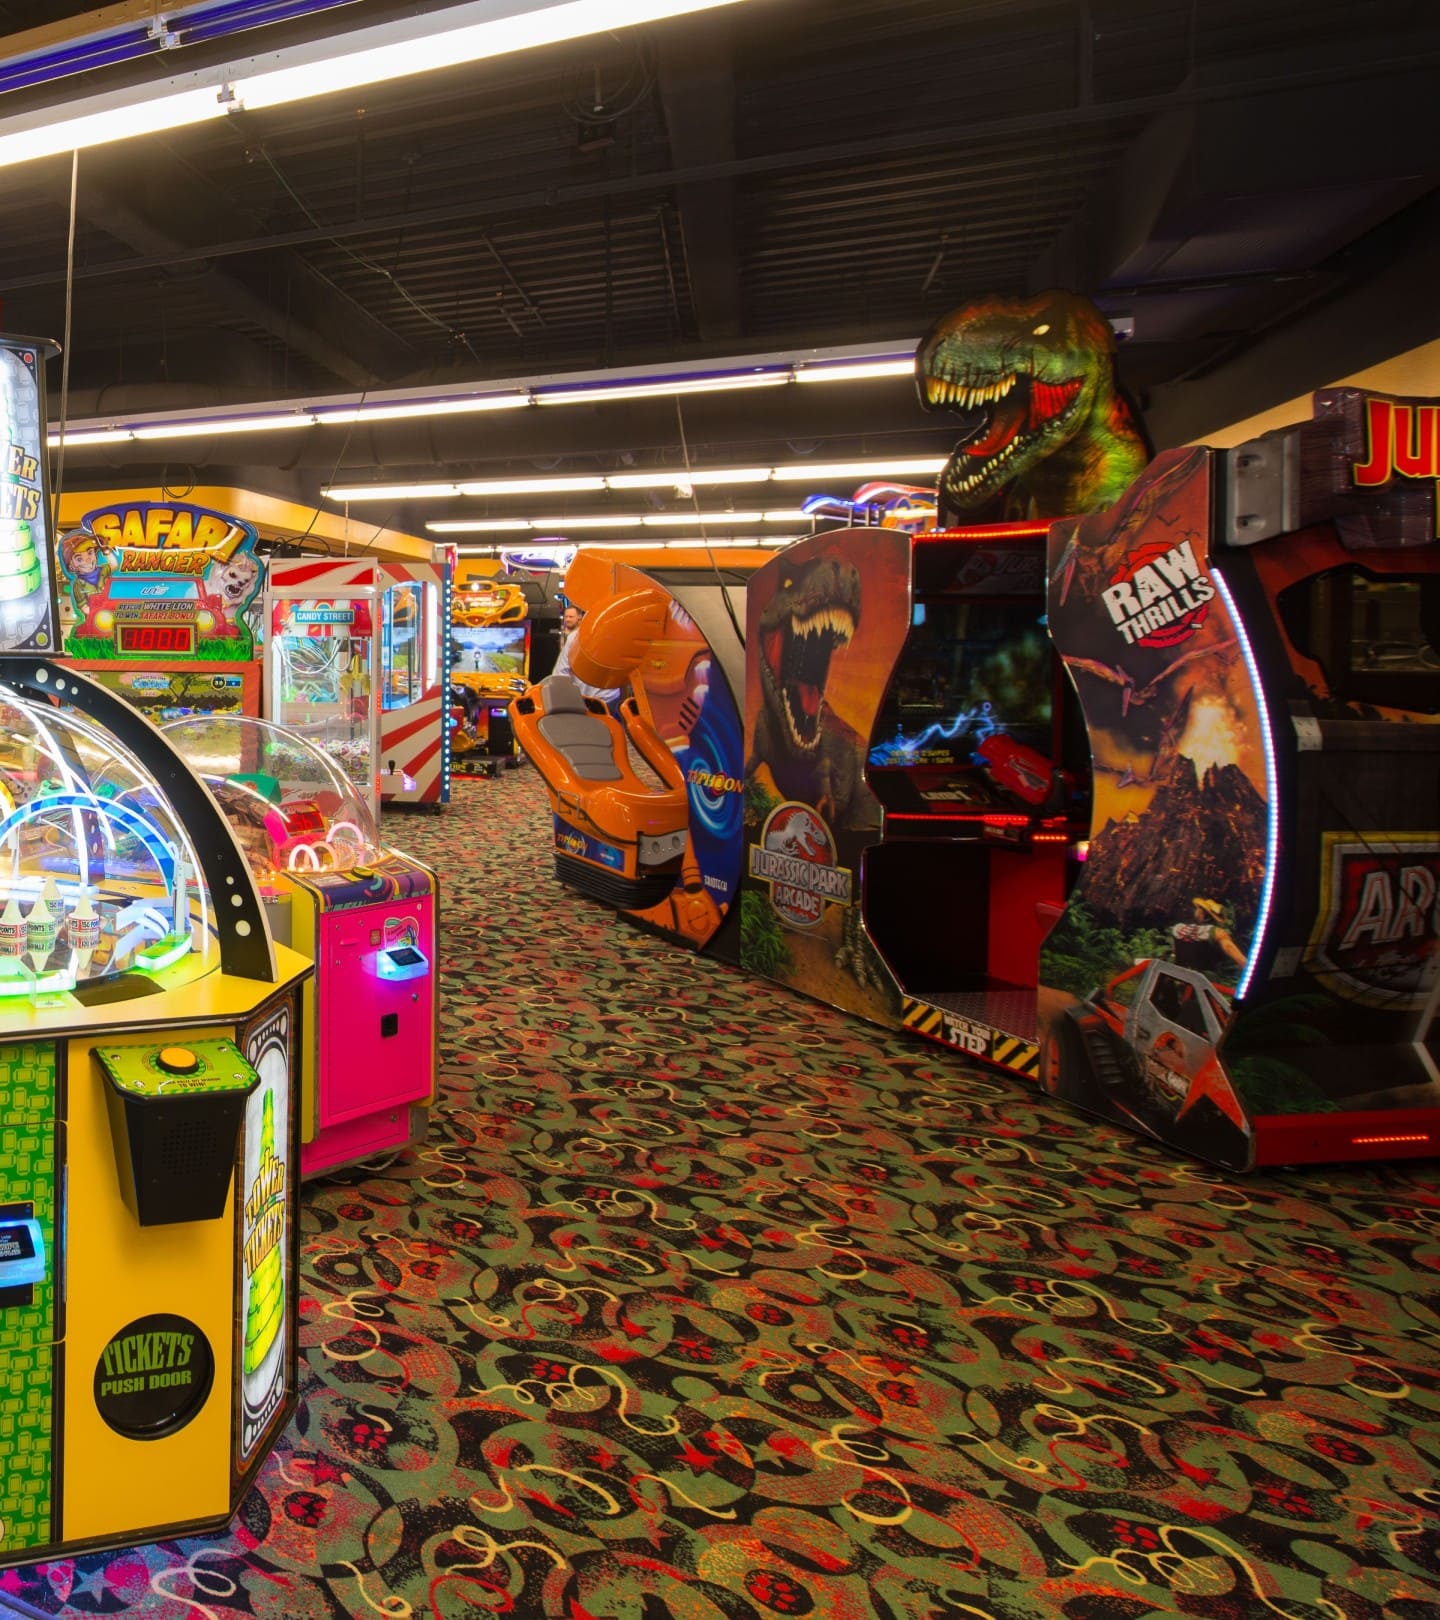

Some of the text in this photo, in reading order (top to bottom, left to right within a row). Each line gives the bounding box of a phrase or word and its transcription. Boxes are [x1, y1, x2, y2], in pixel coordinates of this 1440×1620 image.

[1353, 398, 1440, 486] JU
[91, 508, 247, 565] SAFARI
[120, 550, 210, 576] RANGER
[1101, 540, 1200, 625] RAW
[143, 602, 171, 611] WHITE
[172, 602, 193, 610] LION
[296, 612, 352, 621] CANDY STREET
[1116, 576, 1215, 644] THRILLS
[687, 769, 744, 795] TYPHOON
[752, 850, 849, 899] JURASSIC PARK
[775, 886, 820, 917] ARCADE
[949, 1027, 987, 1055] STEP
[245, 1146, 286, 1230] TOWER
[244, 1198, 286, 1280] TICKETS
[102, 1331, 195, 1376] TICKETS
[101, 1370, 192, 1397] PUSH DOOR
